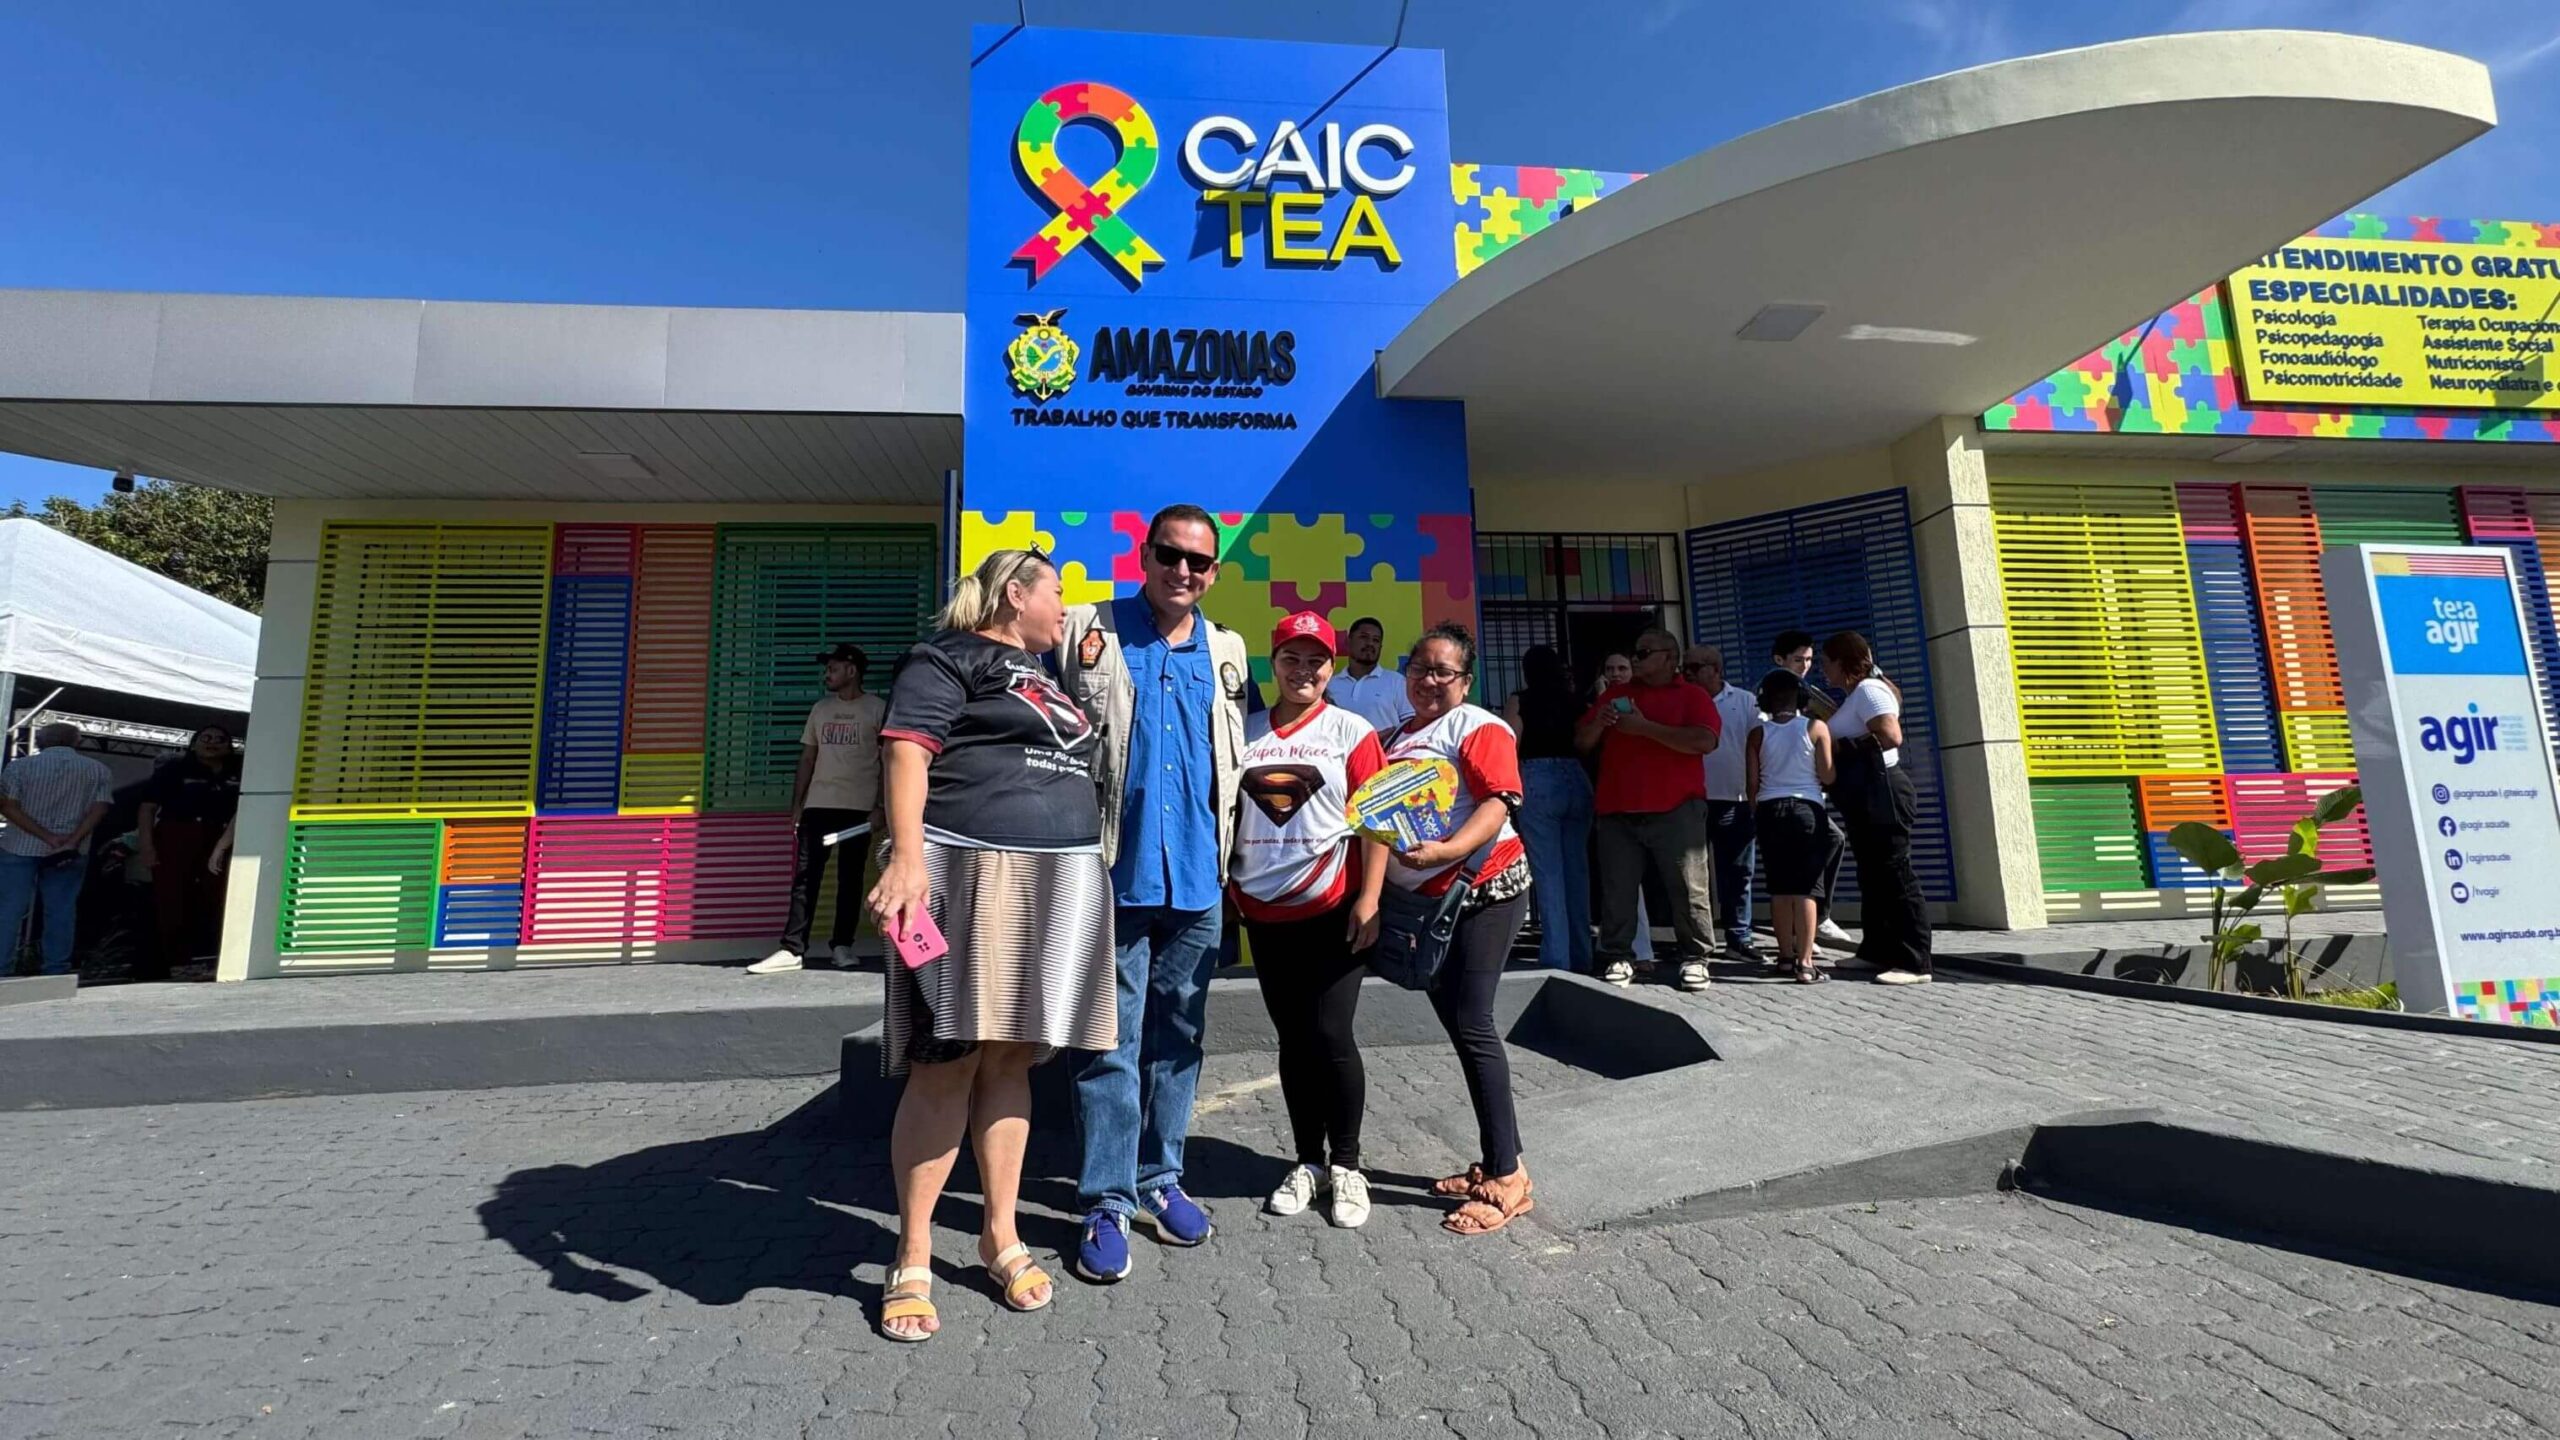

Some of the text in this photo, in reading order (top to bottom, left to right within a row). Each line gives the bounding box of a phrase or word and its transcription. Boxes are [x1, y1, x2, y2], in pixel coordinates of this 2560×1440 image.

[1185, 116, 1416, 193] CAIC
[1203, 190, 1402, 263] TEA
[2249, 280, 2517, 310] ESPECIALIDADES:
[2252, 309, 2337, 328] Psicologia
[2416, 315, 2476, 333] Terapia
[2256, 329, 2384, 350] Psicopedagogia
[2423, 335, 2554, 353] Assistente Social
[1092, 327, 1296, 383] AMAZONAS
[2260, 350, 2379, 370] Fonoaudiólogo
[2425, 354, 2525, 371] Nutricionista
[2263, 370, 2403, 388] Psicomotricidade
[2429, 374, 2540, 393] Neuropediatra
[2543, 381, 2553, 391] e
[1126, 384, 1263, 399] GOVERNO DO ESTADO
[1011, 408, 1297, 431] TRABALHO QUE TRANSFORMA
[2425, 620, 2479, 653] agir
[2419, 702, 2499, 765] agir
